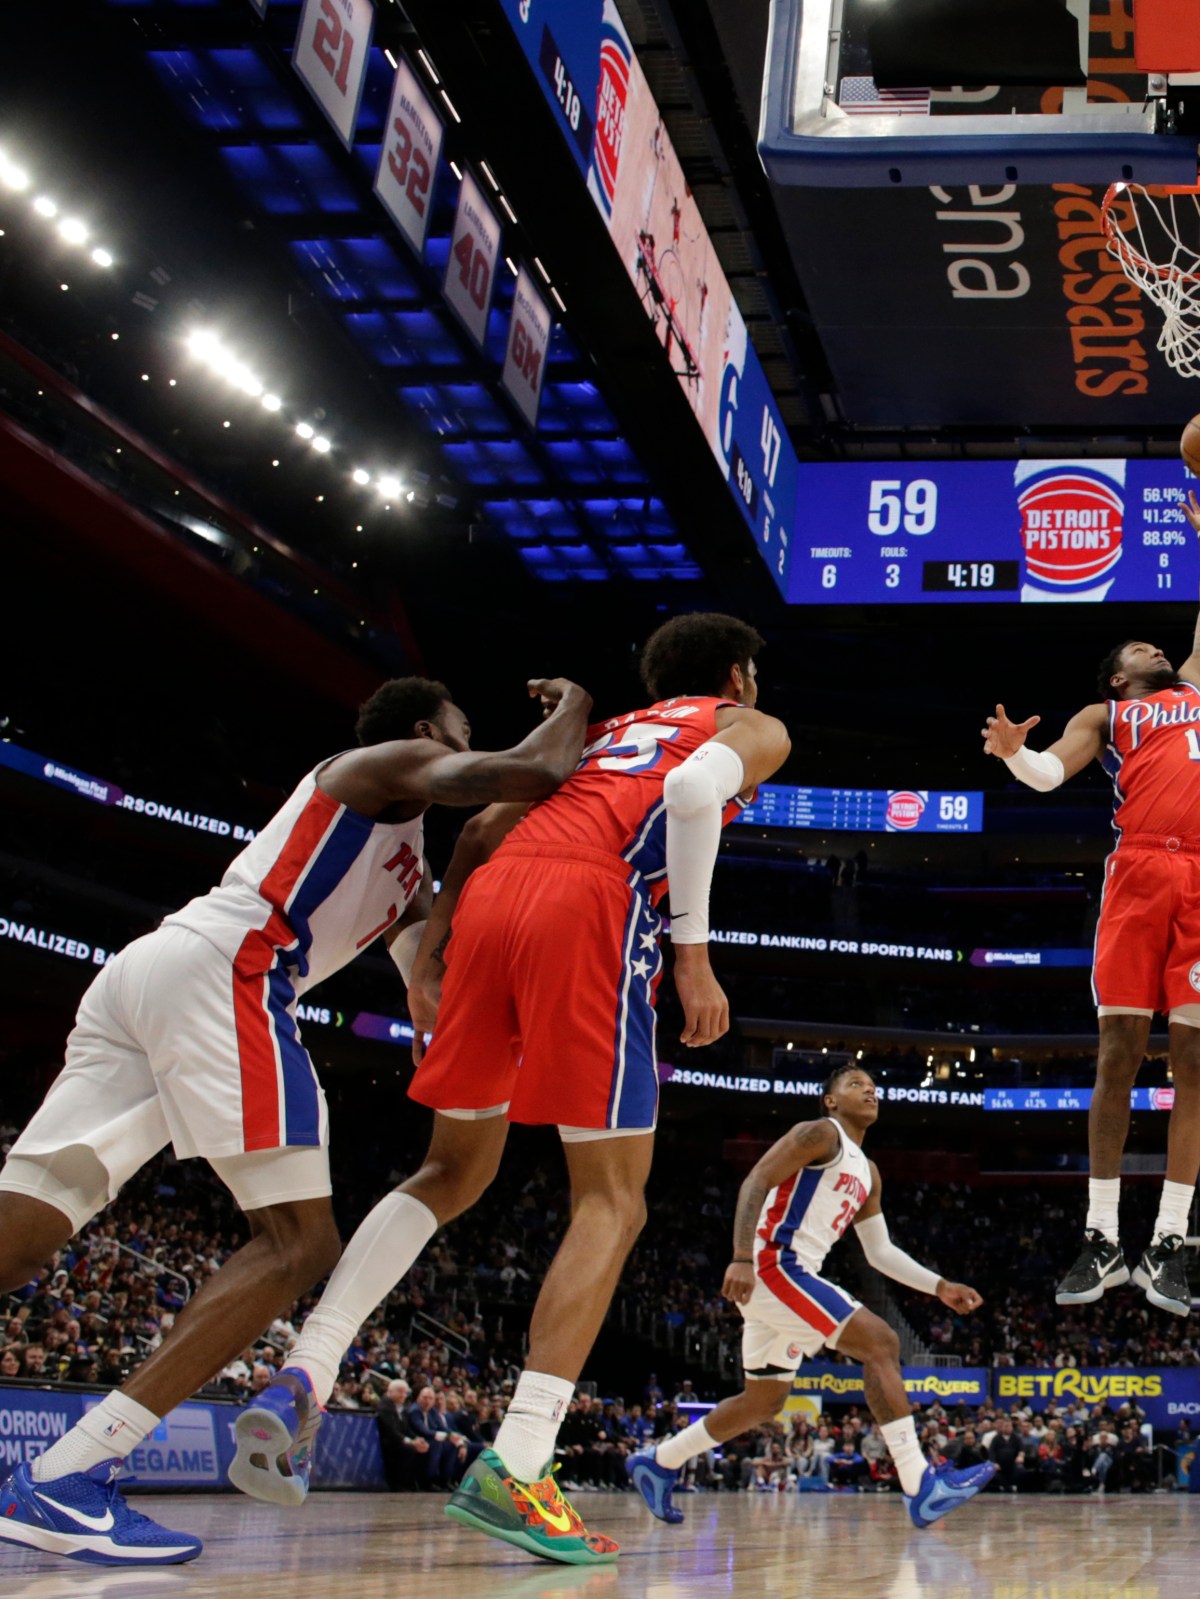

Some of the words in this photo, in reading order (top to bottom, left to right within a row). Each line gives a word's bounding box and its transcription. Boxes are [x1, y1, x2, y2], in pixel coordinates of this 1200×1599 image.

[312, 0, 354, 97] 21
[554, 56, 581, 131] 4:18
[400, 94, 433, 155] HAMILTON
[387, 117, 430, 219] 32
[453, 232, 490, 311] 40
[1052, 183, 1160, 398] aesars
[761, 404, 781, 488] 47
[868, 480, 938, 535] 59
[1143, 488, 1186, 502] 56.4%
[1026, 509, 1109, 530] DETROIT
[1143, 509, 1186, 523] 41.2%
[1024, 528, 1110, 550] PISTONS
[1143, 531, 1186, 545] 88.9%
[810, 548, 852, 558] TIMEOUTS:
[880, 547, 907, 558] FOULS:
[1159, 553, 1168, 567] 6
[822, 565, 836, 588] 6
[885, 564, 899, 588] 3
[948, 564, 994, 587] 4:19
[1157, 574, 1171, 588] 11
[116, 795, 230, 835] RSONALIZED
[939, 796, 969, 820] 59
[760, 934, 827, 950] BANKING
[830, 939, 858, 953] FOR
[861, 942, 915, 958] SPORTS
[917, 947, 953, 961] FANS
[668, 1070, 770, 1093] RSONALIZED
[774, 1081, 823, 1095] BANK
[888, 1088, 946, 1104] SPORTS
[905, 1376, 980, 1396] ETRIVERS
[998, 1368, 1162, 1403] BETRIVERS
